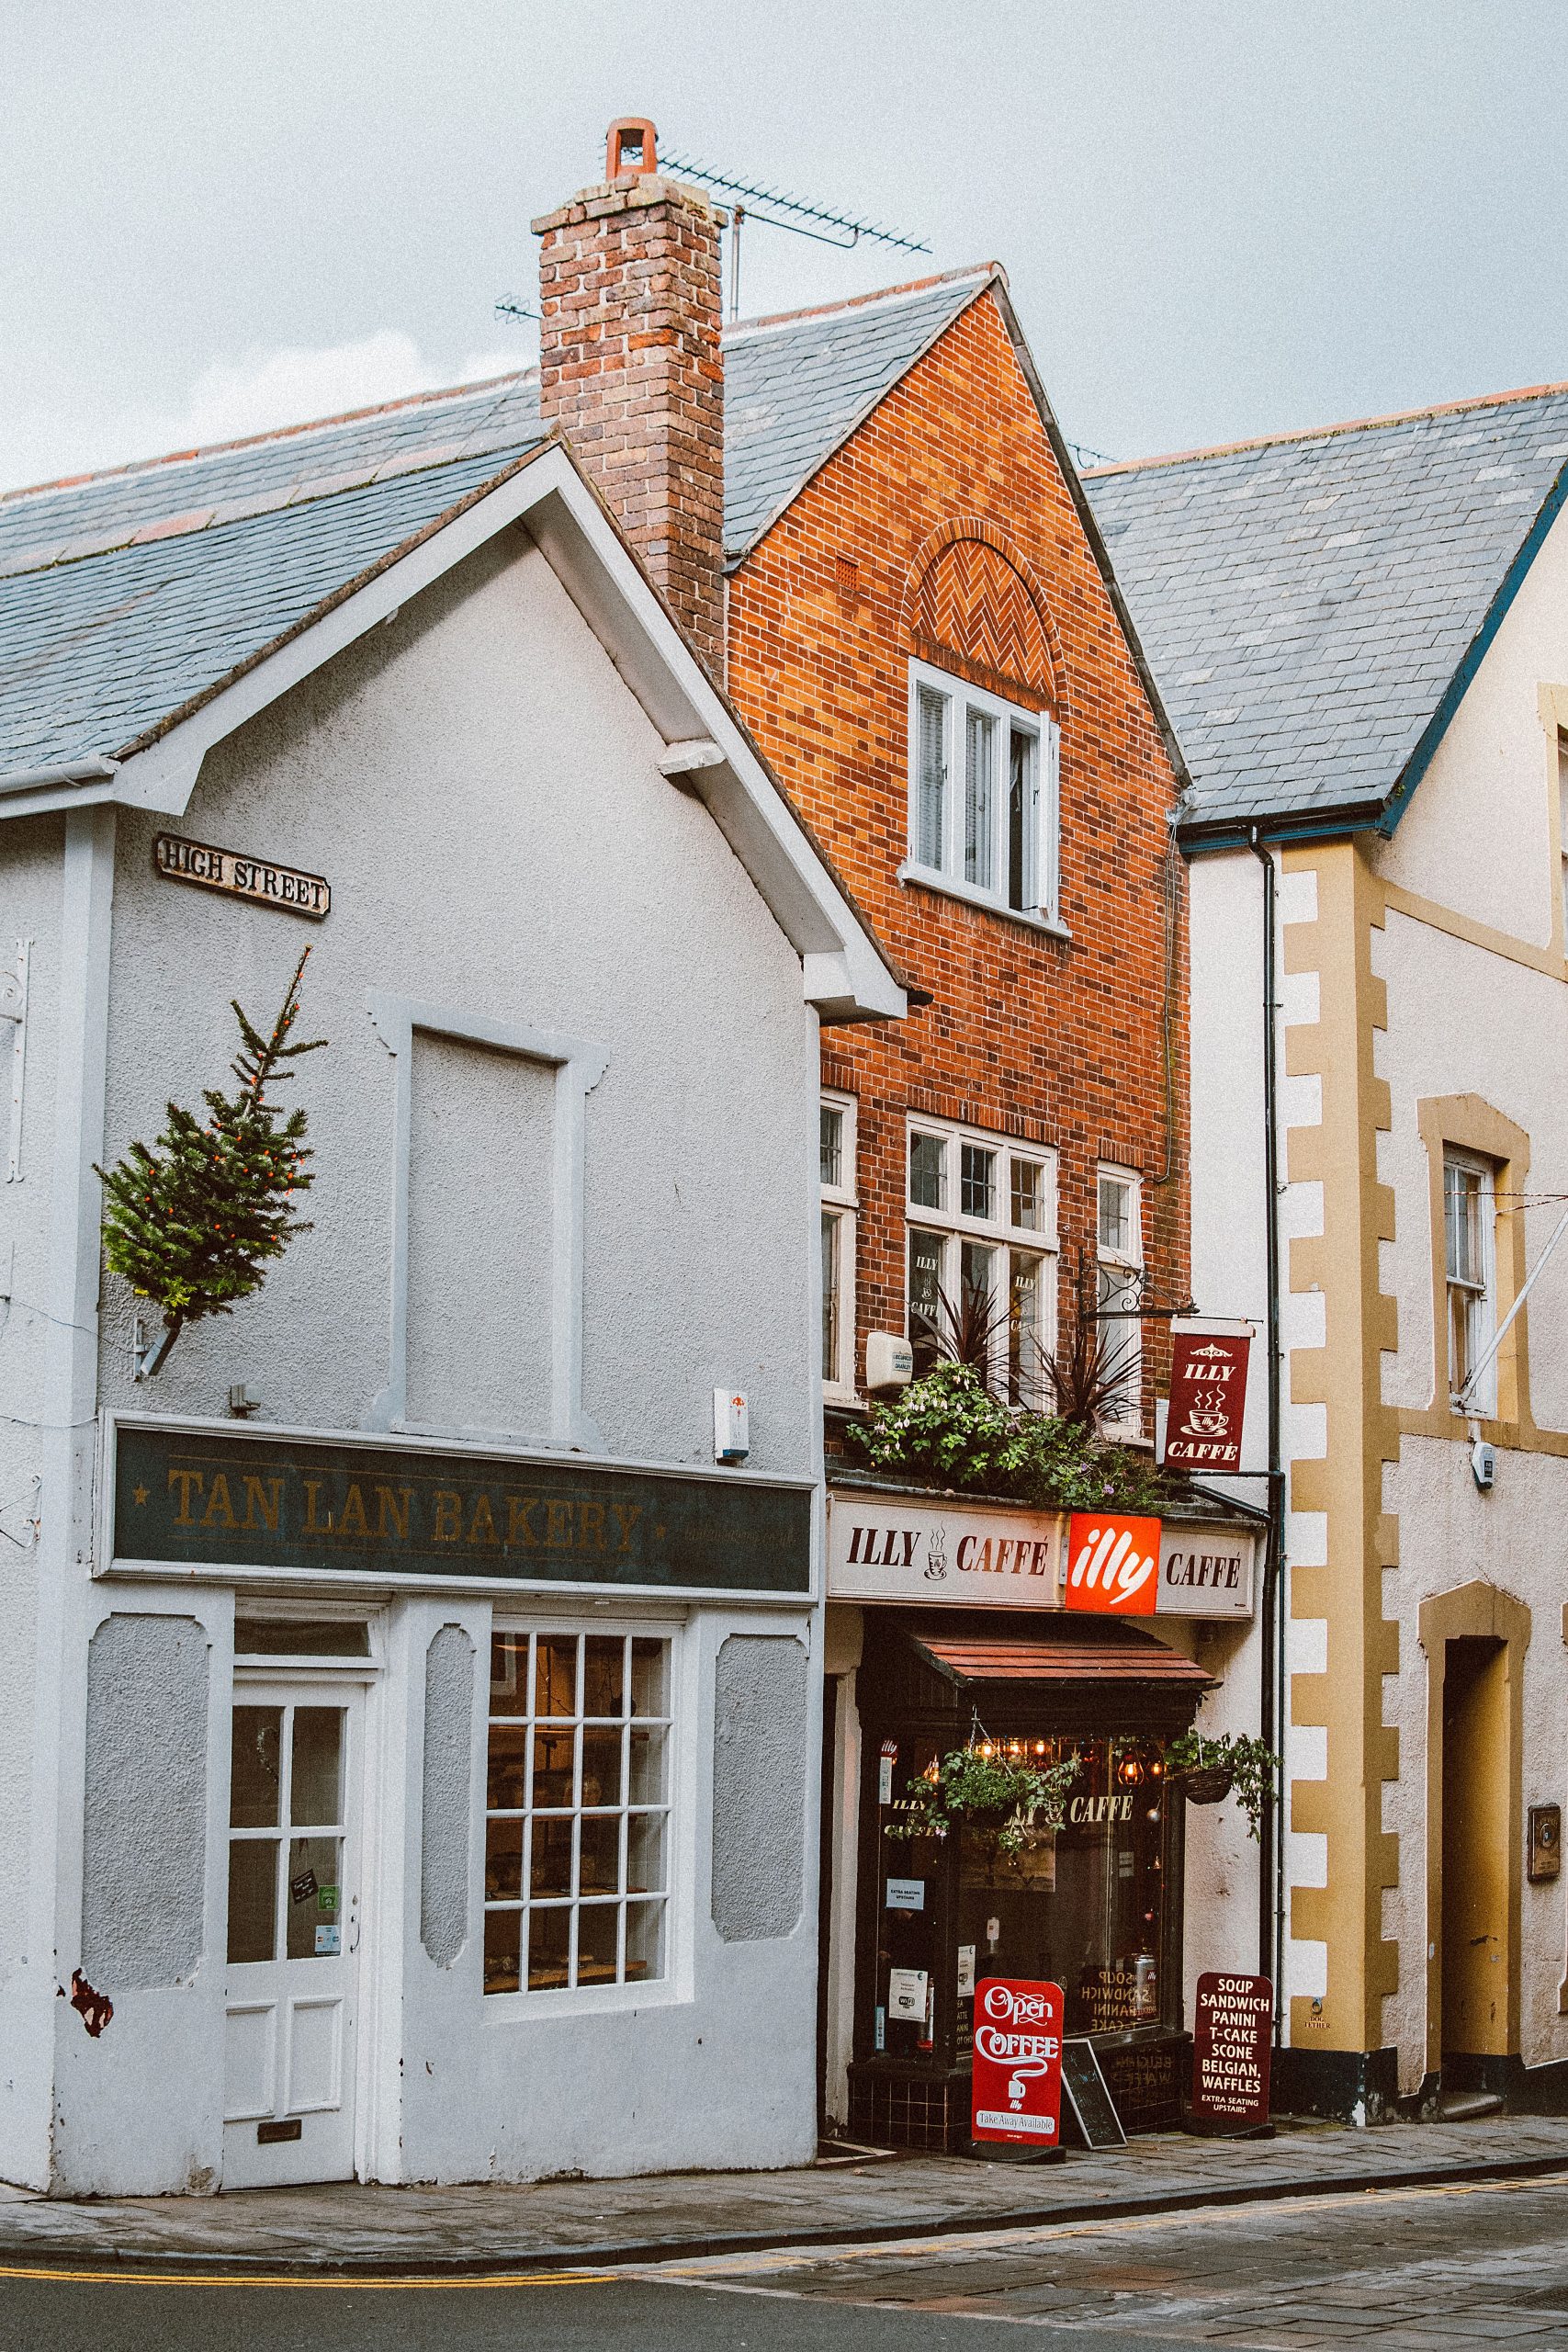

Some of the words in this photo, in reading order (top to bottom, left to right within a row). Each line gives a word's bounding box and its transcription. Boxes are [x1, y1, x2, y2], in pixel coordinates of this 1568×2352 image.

[164, 840, 224, 882] HIGH
[234, 861, 324, 910] STREET
[916, 1256, 938, 1271] ILLY
[1014, 1276, 1035, 1290] ILLY
[1183, 1363, 1236, 1381] ILLY
[1168, 1442, 1238, 1461] CAFFÉ
[167, 1468, 286, 1531] TAN
[300, 1479, 413, 1541] LAN
[433, 1489, 644, 1553] BAKERY
[845, 1526, 921, 1567] ILLY
[956, 1531, 1049, 1577] CAFFÉ
[1071, 1527, 1155, 1604] illy
[1166, 1551, 1242, 1589] CAFFÉ
[881, 1739, 897, 1756] illy
[1070, 1789, 1134, 1824] CAFFÉ
[1217, 1978, 1254, 1994] SOUP
[984, 1985, 1053, 2026] Open
[1200, 1993, 1269, 2012] SANDWICH
[1212, 2010, 1256, 2028] PANINI
[1209, 2026, 1258, 2044] T-CAKE
[976, 2026, 1059, 2064] COFFEE
[1212, 2043, 1253, 2060] SCONE
[1201, 2059, 1261, 2079] BELGIAN,
[1201, 2075, 1261, 2094] WAFFLES
[1201, 2094, 1226, 2104] EXTRA
[1228, 2097, 1259, 2108] SEATING
[1213, 2104, 1247, 2114] UPSTAIRS
[979, 2113, 998, 2124] Take
[999, 2115, 1019, 2129] Away
[1019, 2117, 1053, 2130] Available
